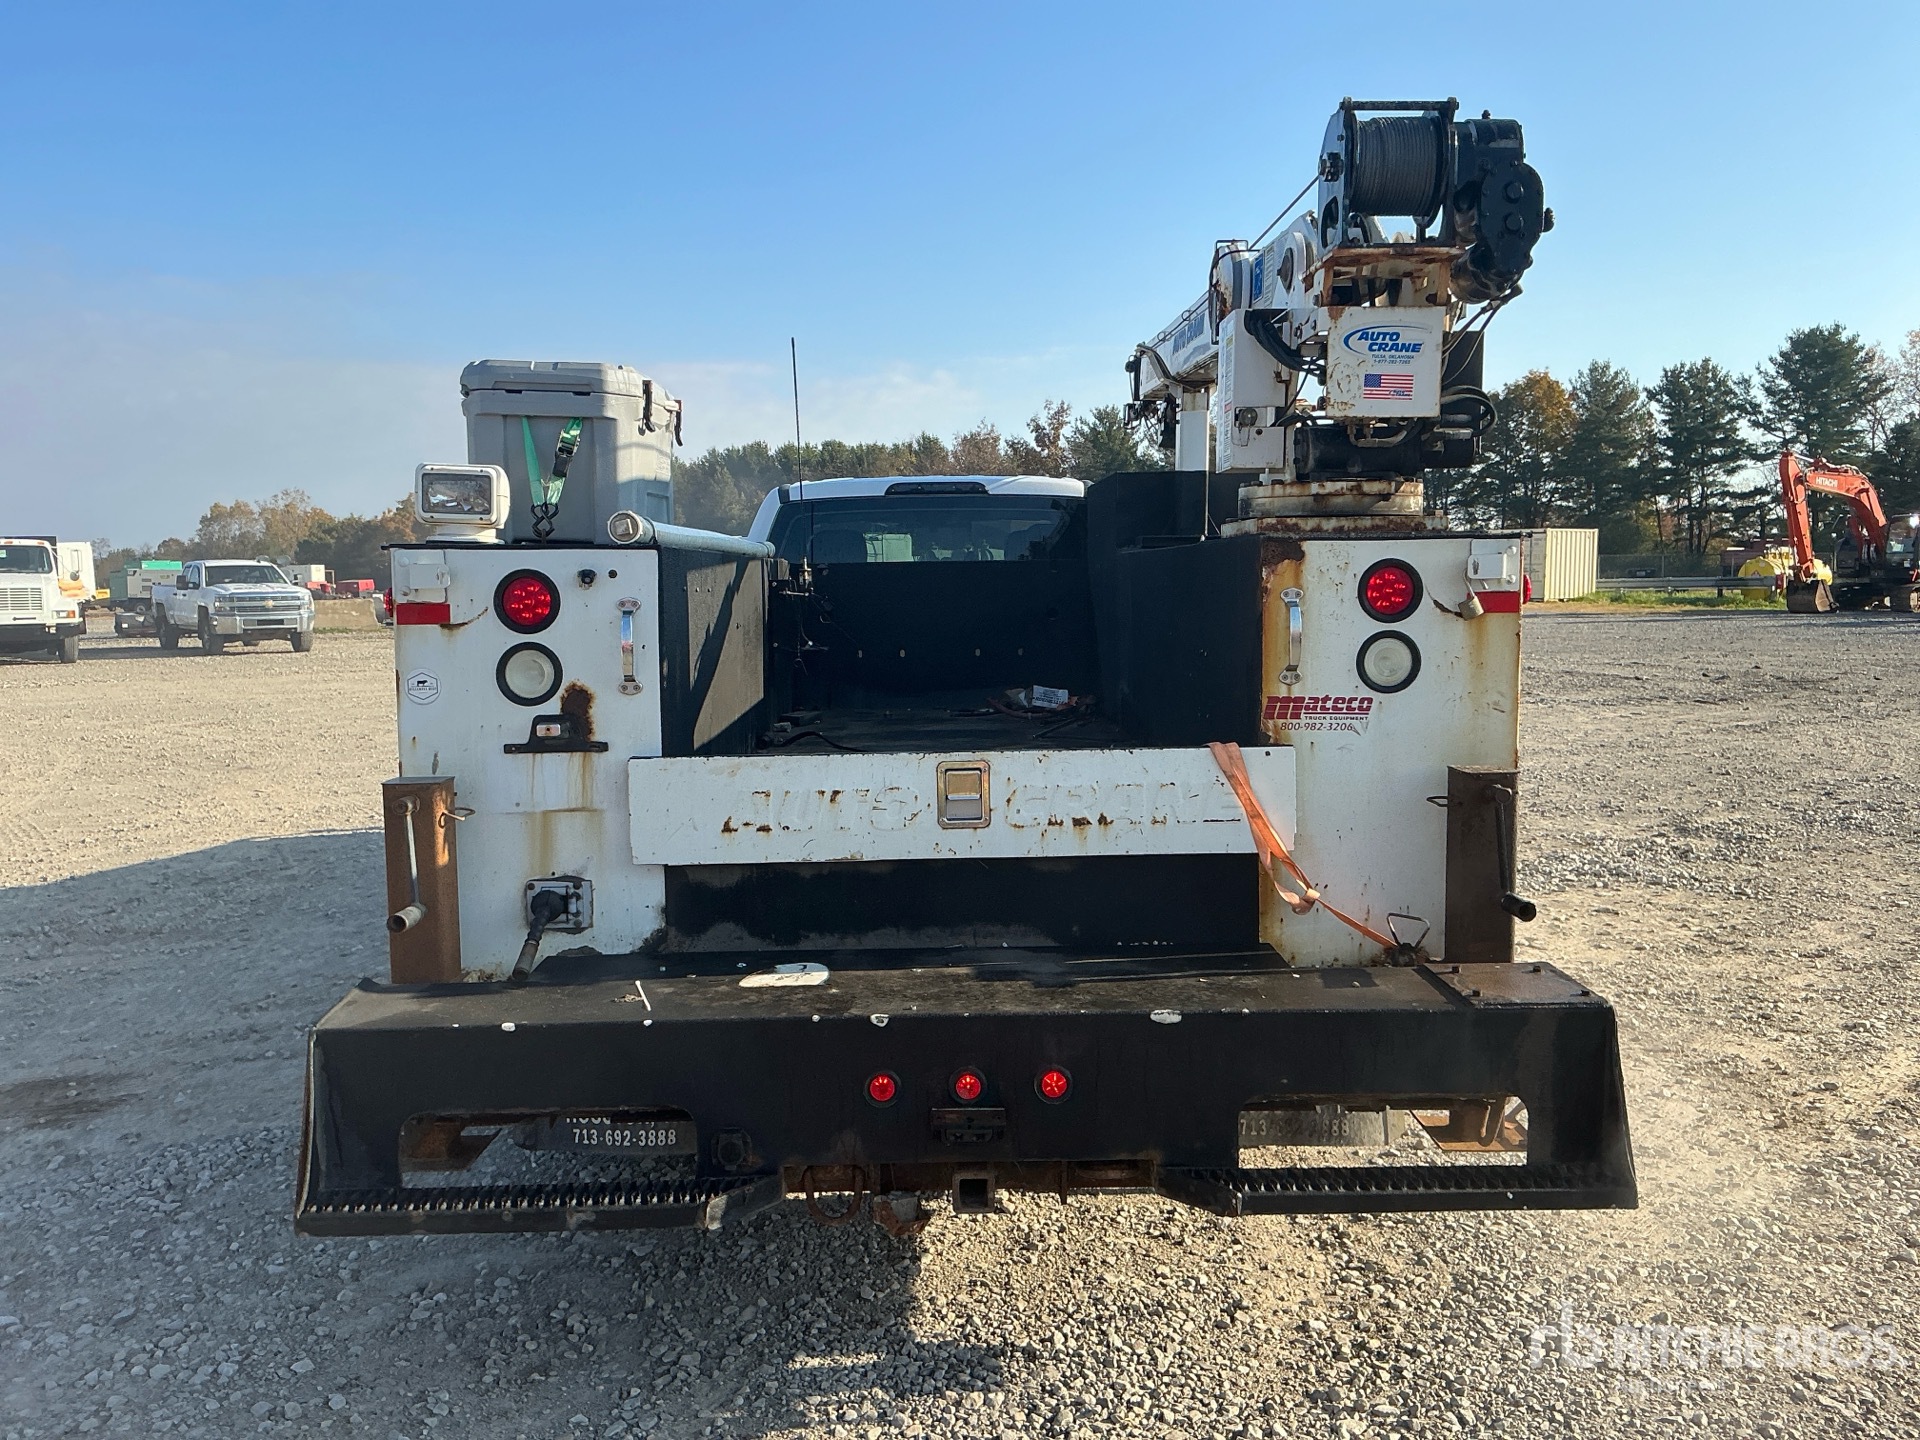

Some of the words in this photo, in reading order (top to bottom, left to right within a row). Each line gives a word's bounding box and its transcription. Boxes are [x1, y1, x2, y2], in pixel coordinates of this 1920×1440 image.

[1357, 331, 1401, 342] AUTO
[1367, 342, 1423, 353] CRANE
[1815, 476, 1838, 488] HITACHI
[1280, 722, 1353, 731] 800-982-3206
